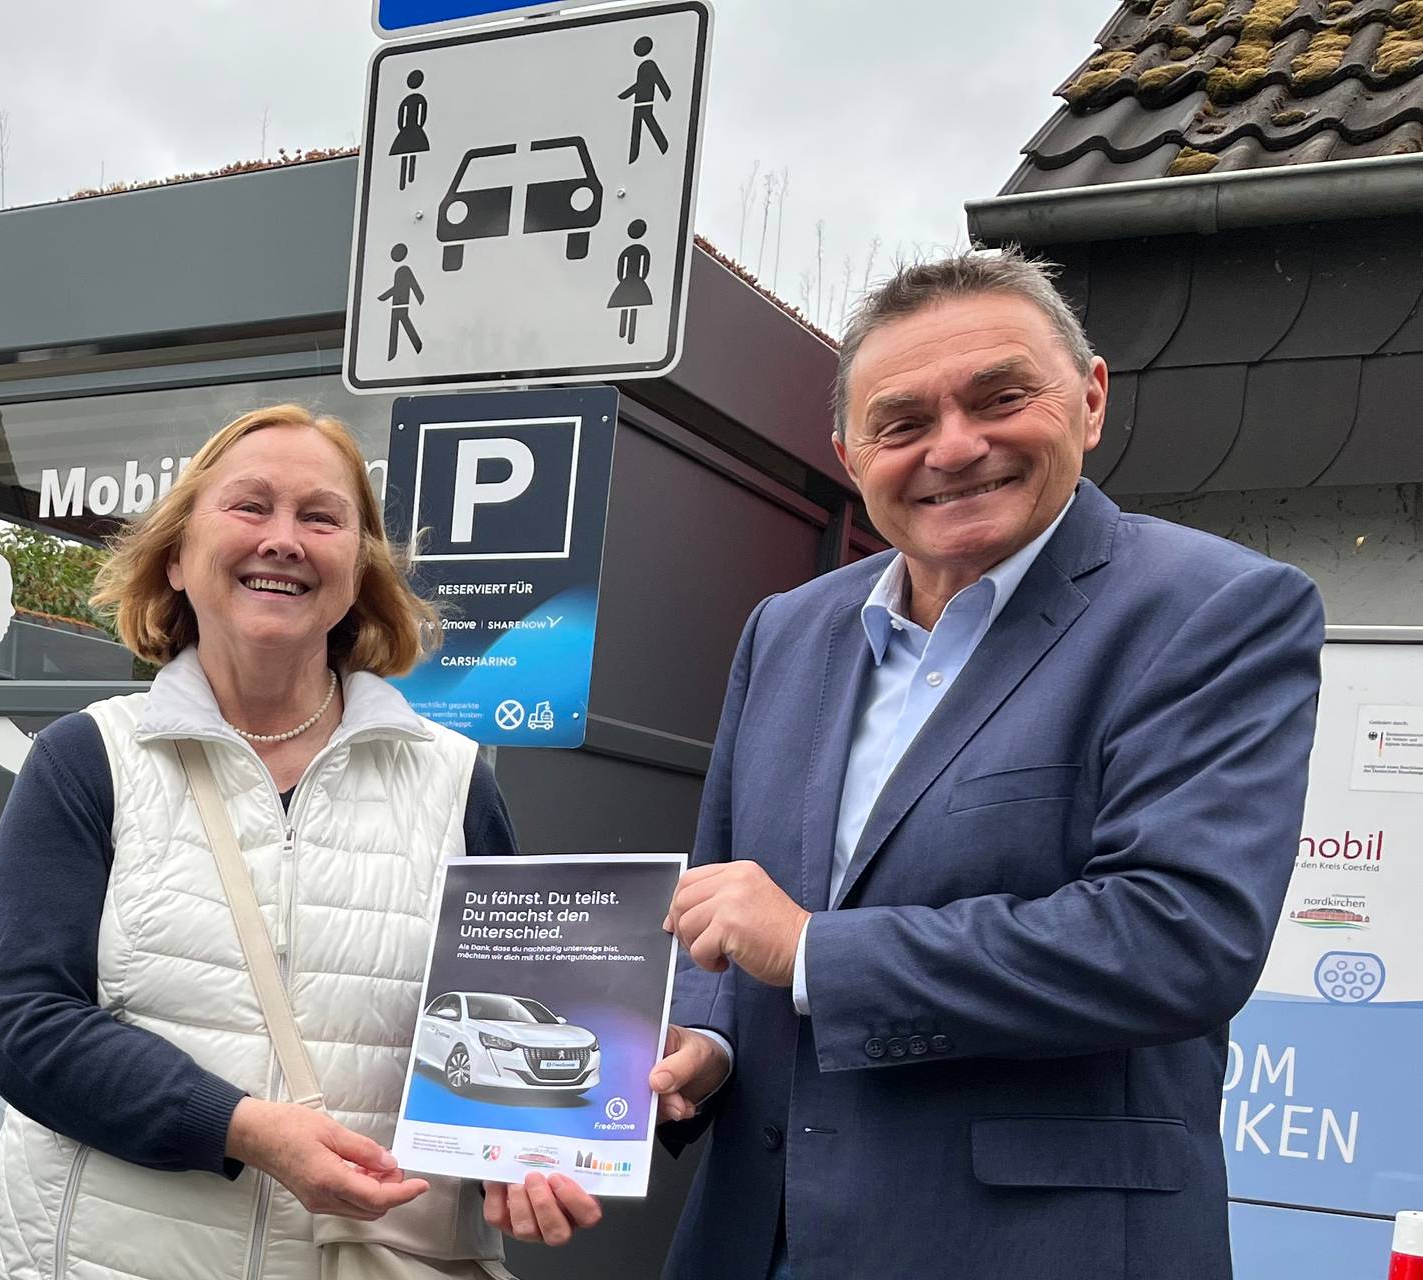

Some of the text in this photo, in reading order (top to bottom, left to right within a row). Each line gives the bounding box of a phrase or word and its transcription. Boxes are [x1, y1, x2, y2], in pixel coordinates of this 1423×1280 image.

[38, 456, 193, 518] Mobi
[450, 437, 535, 543] P
[438, 580, 533, 595] RESERVIERT FÜR
[441, 656, 517, 667] CARSHARING
[1300, 861, 1317, 869] den
[1319, 862, 1340, 870] Kreis
[1342, 863, 1379, 872] Coesfeld
[464, 890, 620, 906] Du fährst. Du teilst.
[1303, 897, 1366, 908] nordkirchen
[462, 908, 589, 922] Du machst den
[460, 924, 563, 939] Unterschied.
[593, 1121, 636, 1130] Free2move
[1220, 1097, 1359, 1164] KEN
